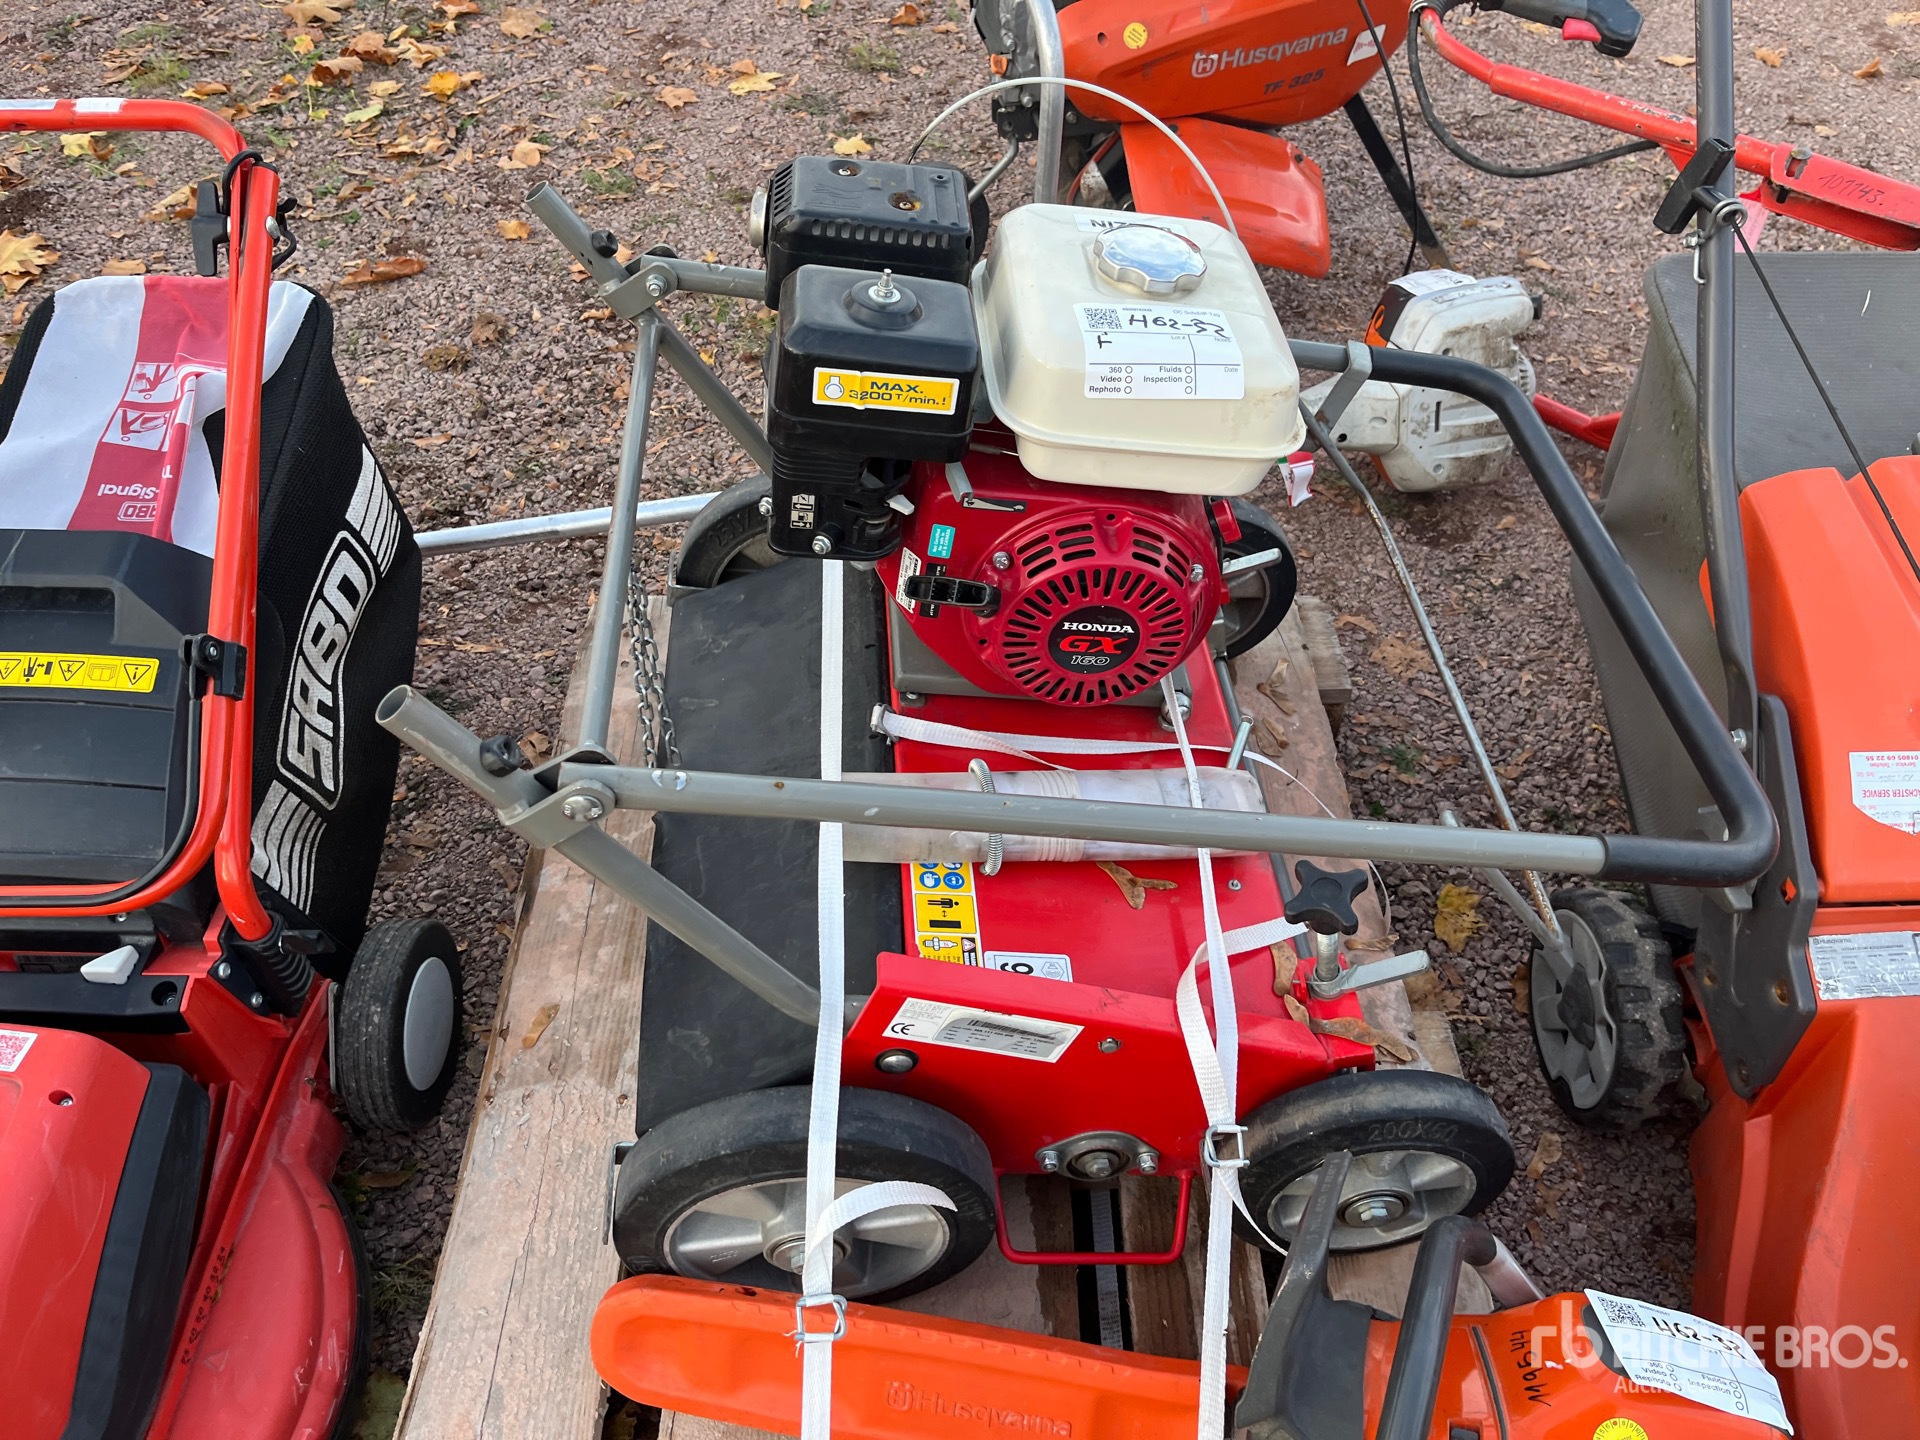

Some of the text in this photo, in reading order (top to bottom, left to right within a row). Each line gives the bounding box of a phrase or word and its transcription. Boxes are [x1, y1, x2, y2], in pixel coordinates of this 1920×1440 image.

[1219, 27, 1348, 71] Husqvarna
[1263, 68, 1326, 95] TF 325
[1108, 366, 1123, 374] 360
[1159, 366, 1183, 374] Fluids
[1143, 376, 1183, 385] Inspection
[870, 381, 924, 394] MAX.
[1089, 386, 1122, 395] Rephoto
[849, 389, 893, 401] 3200
[1062, 621, 1135, 634] HONDA
[1059, 635, 1129, 655] GX
[1070, 654, 1110, 666] 160
[287, 549, 369, 792] SABO
[1862, 789, 1891, 798] SERVICE
[1641, 1366, 1668, 1377] Video
[1634, 1374, 1672, 1387] Rephoto
[1687, 1378, 1732, 1396] Inspection
[916, 1388, 1073, 1439] Husqvarna
